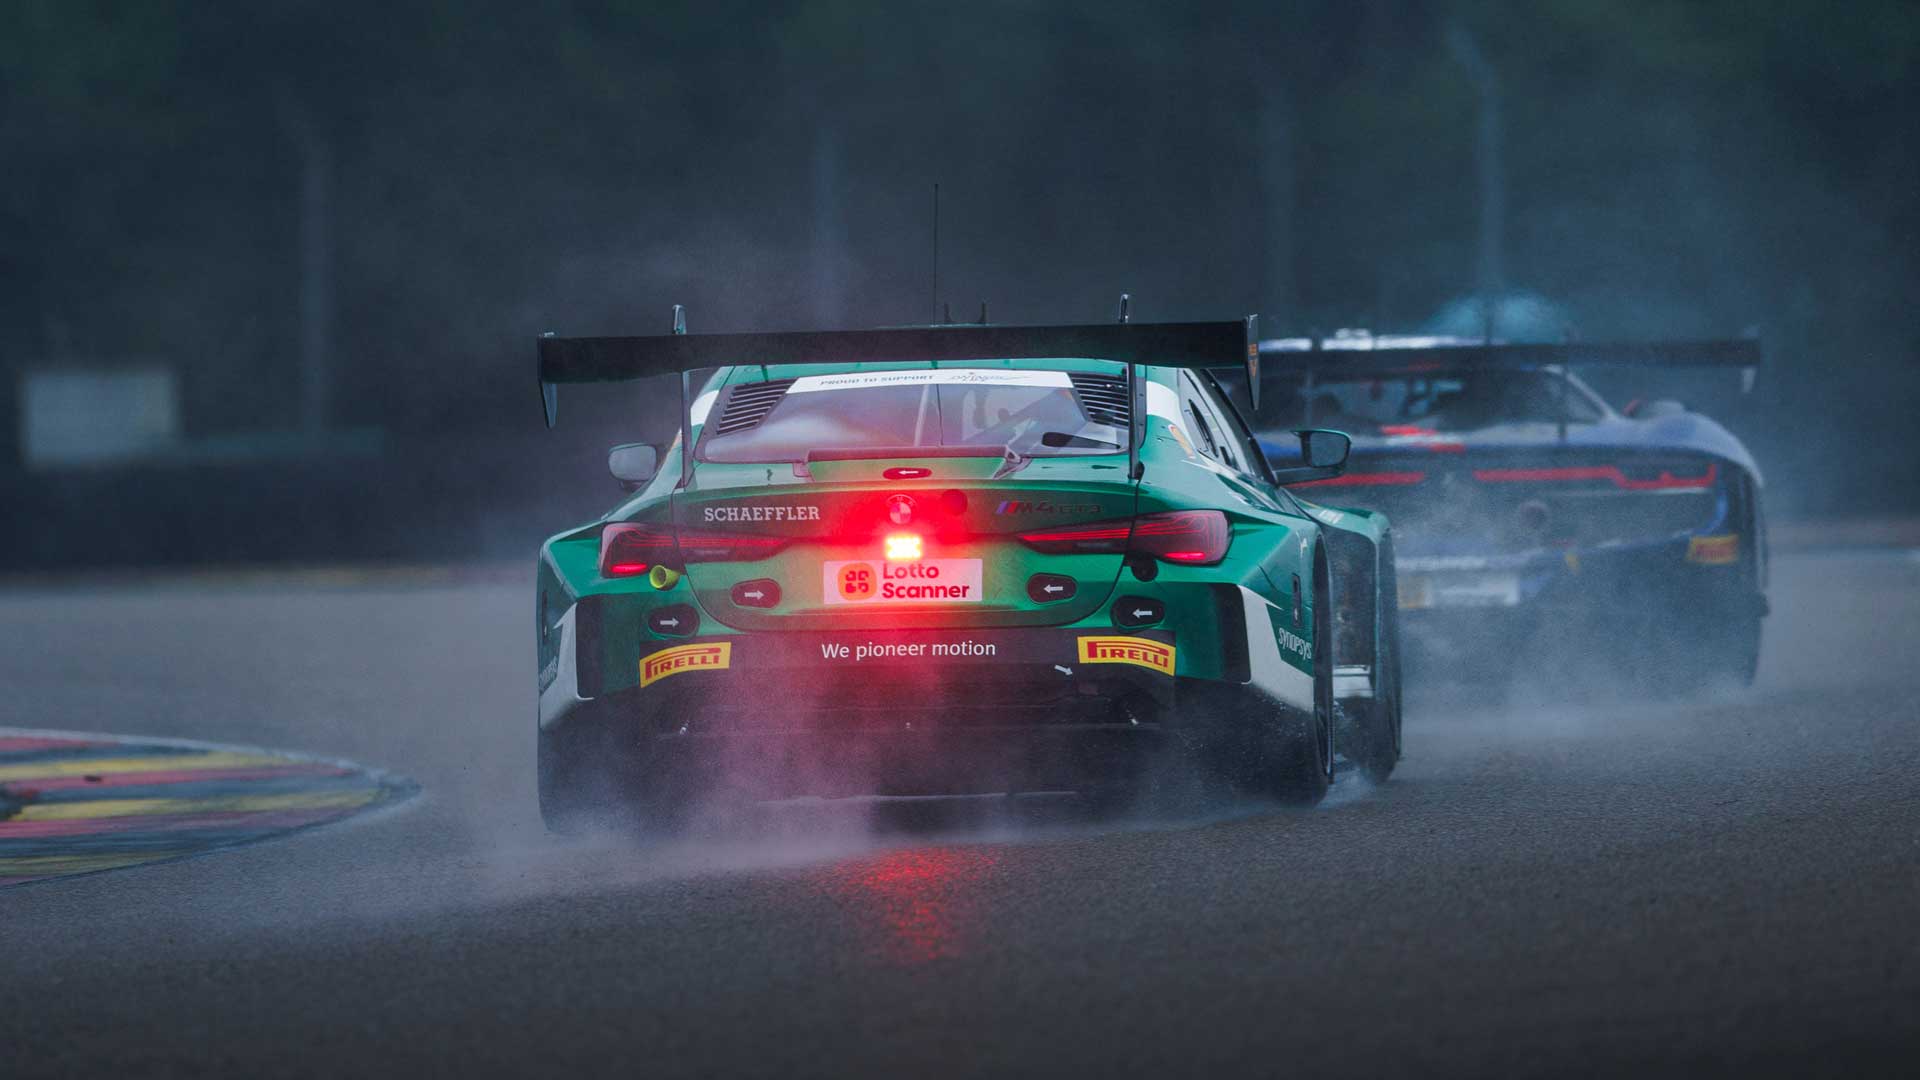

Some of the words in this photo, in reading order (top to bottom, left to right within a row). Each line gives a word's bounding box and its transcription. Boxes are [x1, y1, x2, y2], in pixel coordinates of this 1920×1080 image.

[704, 506, 821, 522] SCHAEFFLER
[883, 563, 940, 579] Lotto
[882, 582, 970, 599] Scanner
[822, 643, 850, 659] We
[856, 641, 927, 661] pioneer
[931, 640, 996, 656] motion
[1087, 641, 1169, 668] PIRELLI
[645, 647, 721, 681] PIRELLI
